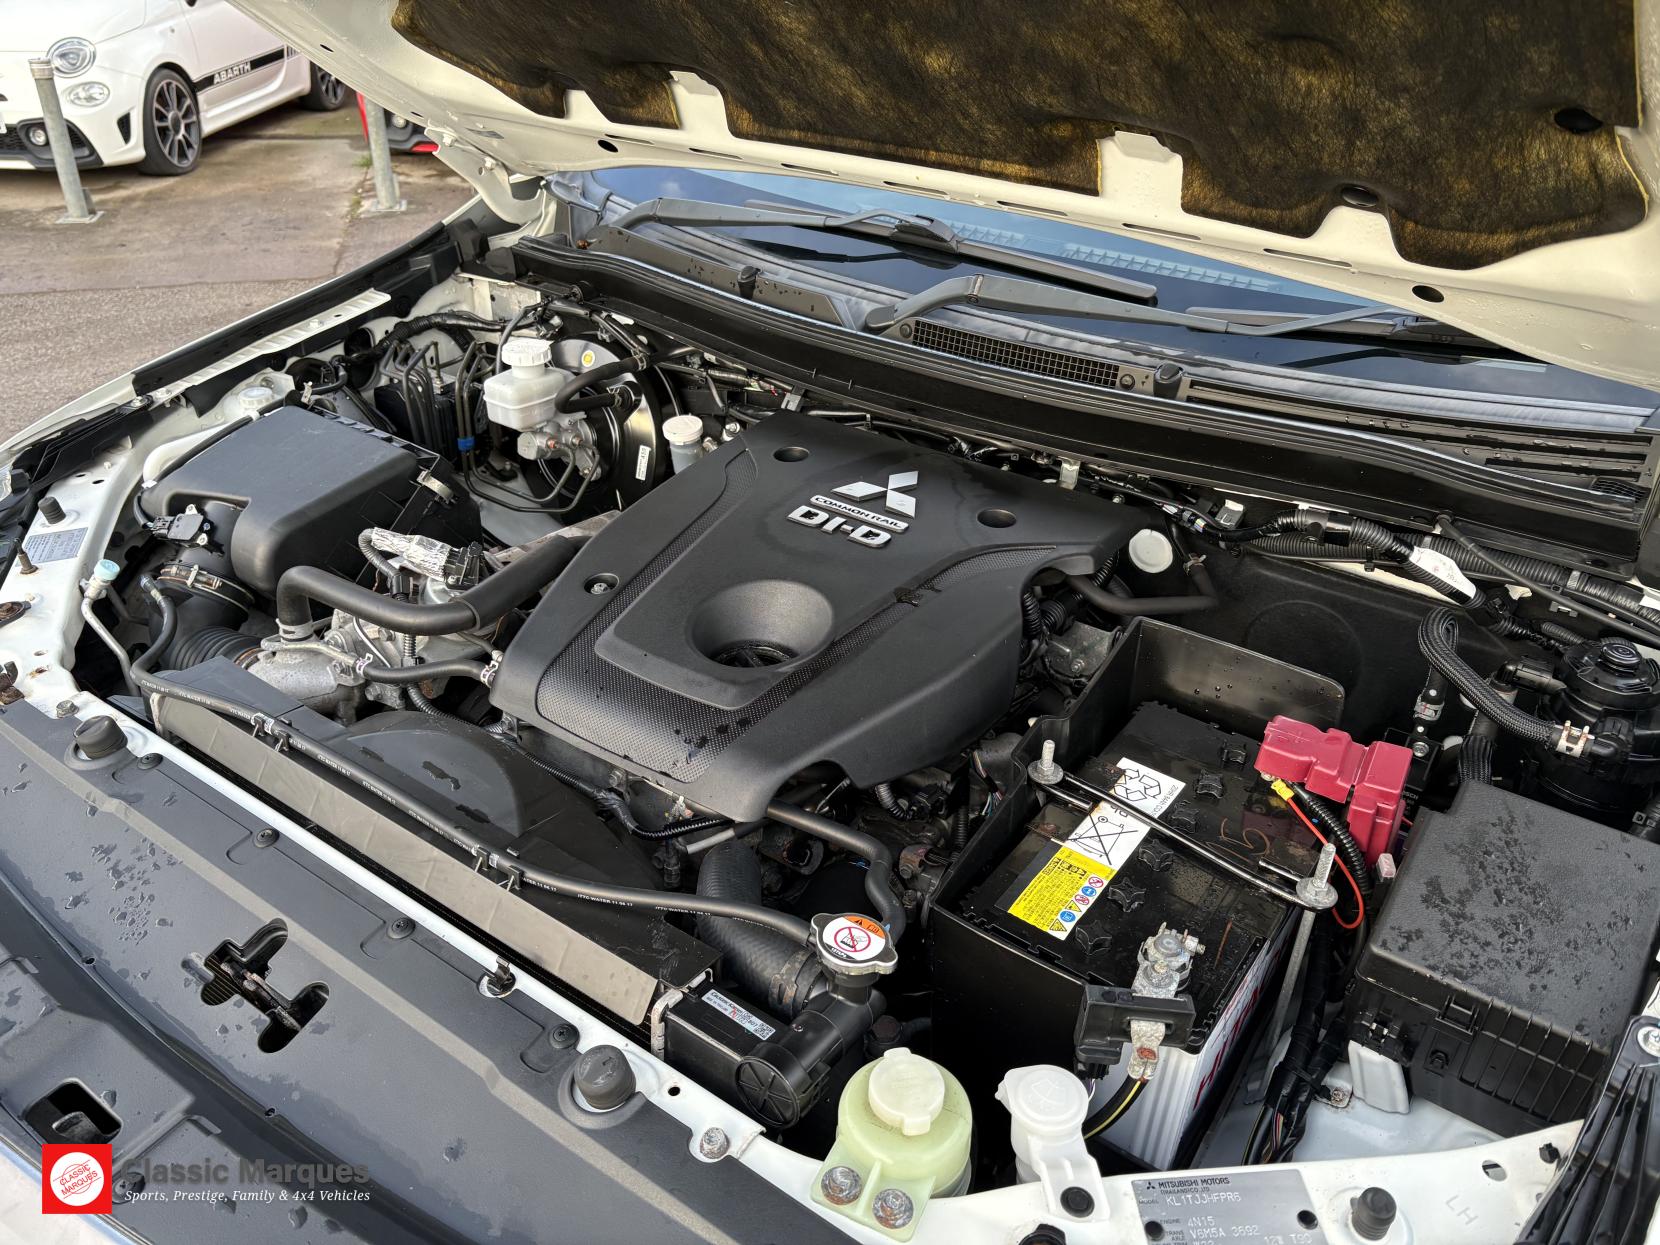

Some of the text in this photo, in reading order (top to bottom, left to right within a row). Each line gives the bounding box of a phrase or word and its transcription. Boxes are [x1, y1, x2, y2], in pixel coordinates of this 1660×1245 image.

[213, 61, 252, 85] ABARTH
[786, 505, 892, 548] DI-D
[815, 496, 903, 529] COMMON RAIL
[1158, 1177, 1230, 1190] MITSUBISHI MOTORS
[1187, 1216, 1216, 1227] 4N15
[1445, 1194, 1479, 1226] LH
